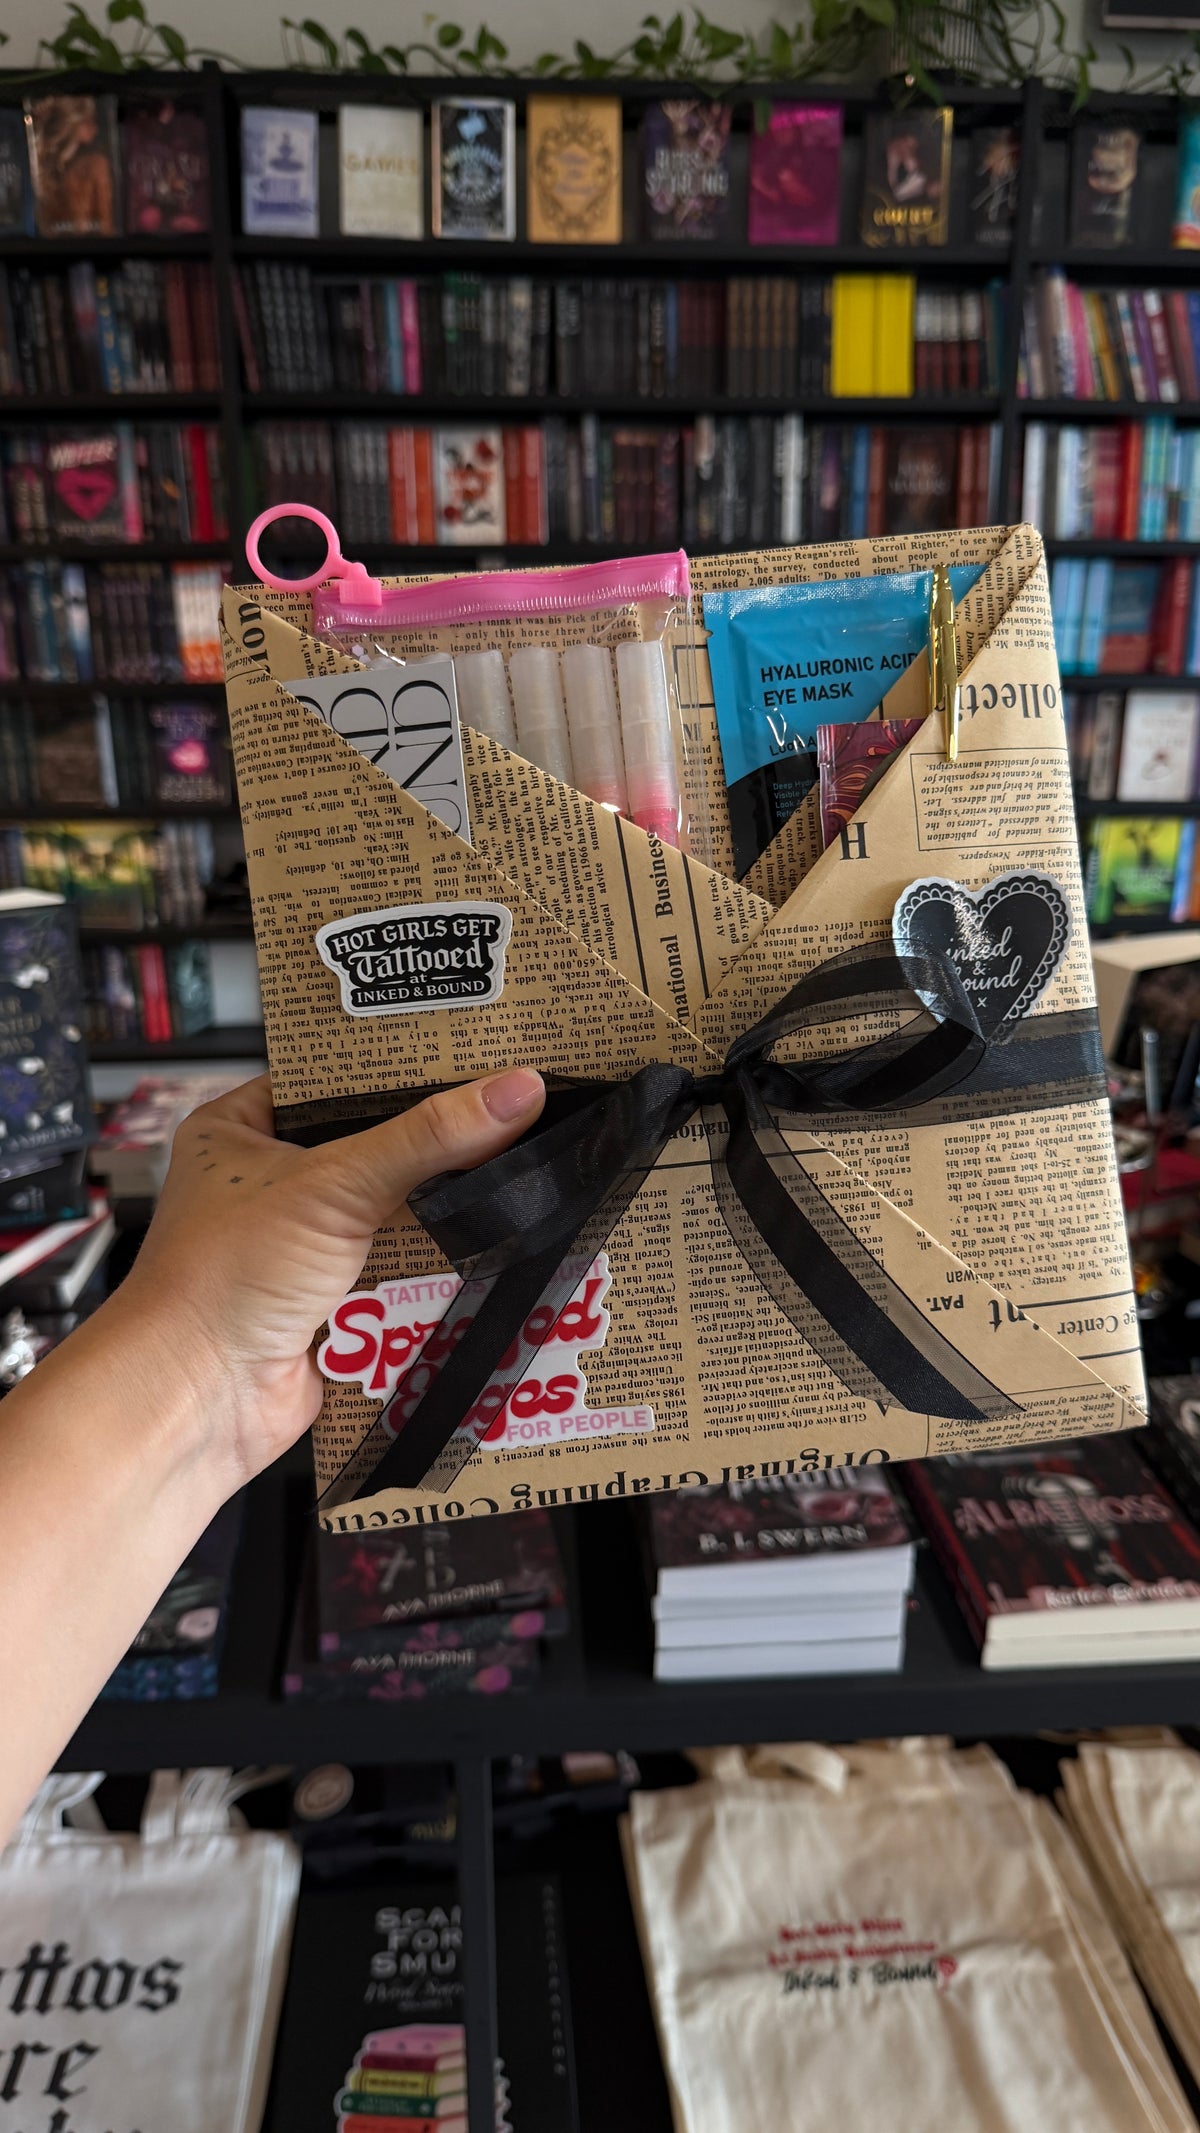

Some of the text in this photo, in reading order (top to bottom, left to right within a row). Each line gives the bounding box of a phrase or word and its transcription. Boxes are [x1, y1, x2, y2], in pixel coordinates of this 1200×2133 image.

[690, 556, 861, 580] on astrology, the survey, conducted
[689, 580, 708, 592] 85,
[760, 655, 875, 684] HYALURONIC
[763, 681, 854, 708] EYE MASK
[274, 816, 415, 843] Has to win, the 10! Definitely!
[548, 813, 560, 833] Mr.
[274, 829, 405, 855] Him: No question. The 10.
[551, 836, 563, 848] of
[555, 850, 573, 905] scheduling
[584, 800, 619, 961] astrological advice something
[707, 873, 726, 937] At the track,
[563, 908, 576, 930] The
[331, 918, 496, 956] HOT GIRLS GET
[347, 936, 486, 984] Tattooed
[954, 954, 1023, 992] ound
[972, 960, 987, 976] &
[357, 980, 485, 1003] INKED & BOUND
[409, 974, 428, 984] at
[659, 934, 690, 1026] national
[926, 1295, 964, 1312] PAT.
[1056, 1314, 1119, 1336] Center
[702, 1381, 835, 1403] But the available evidence
[506, 1409, 649, 1443] FOR PEOPLE
[703, 1412, 868, 1440] GLIB view of the matter holds that
[705, 1400, 867, 1427] the First Family's faith in astrolo-
[493, 1432, 690, 1465] No was the answer from 88 percent; 8
[757, 1524, 869, 1549] SWERN
[0, 1939, 185, 2019] ttoos
